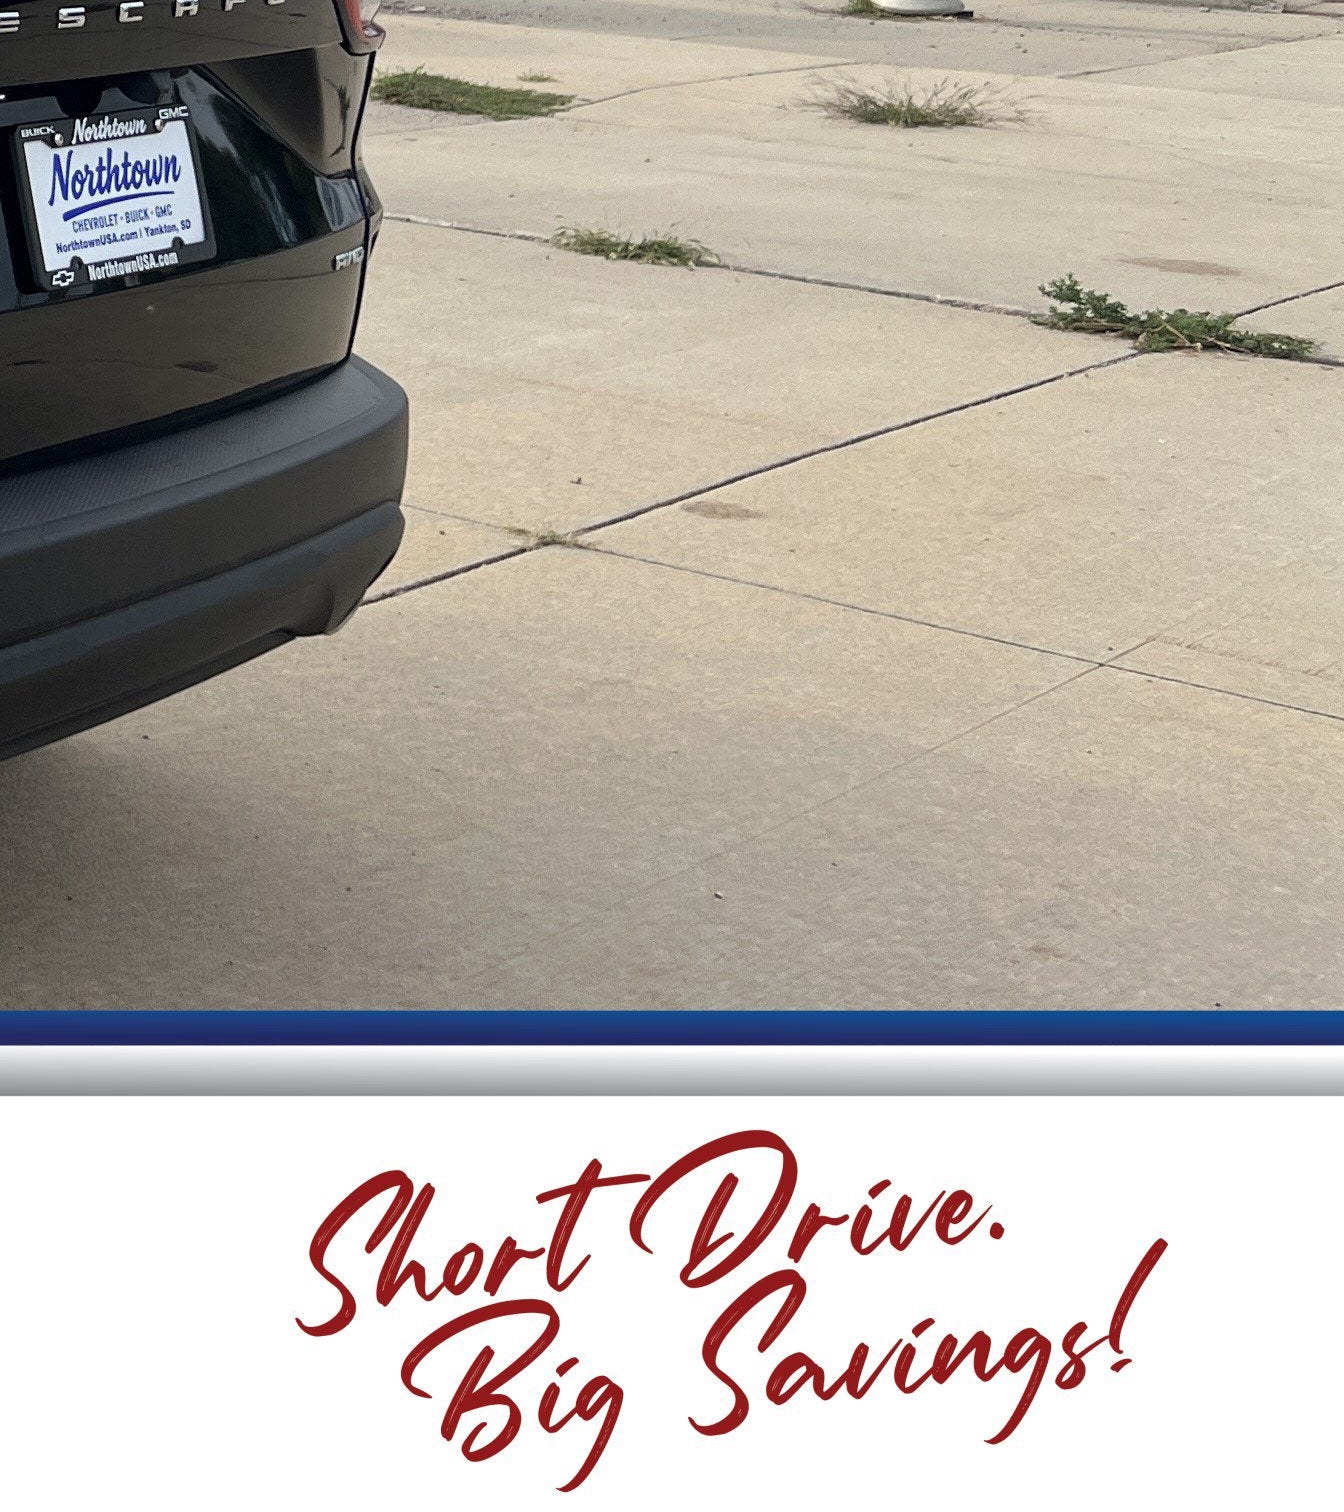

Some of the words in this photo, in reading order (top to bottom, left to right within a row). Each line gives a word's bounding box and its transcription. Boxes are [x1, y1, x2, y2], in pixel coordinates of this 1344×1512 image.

[20, 124, 56, 139] BUICK
[71, 115, 148, 146] Northtown
[158, 105, 190, 120] GMC
[47, 146, 182, 207] Northtown
[55, 231, 139, 255] NorthtownUSA.com
[143, 223, 180, 238] Yankton,
[181, 218, 192, 230] SD
[72, 212, 119, 234] CHEVROLET
[124, 207, 150, 224] BUICK
[154, 203, 173, 218] GMC
[87, 251, 180, 282] NorthtownUSA.com
